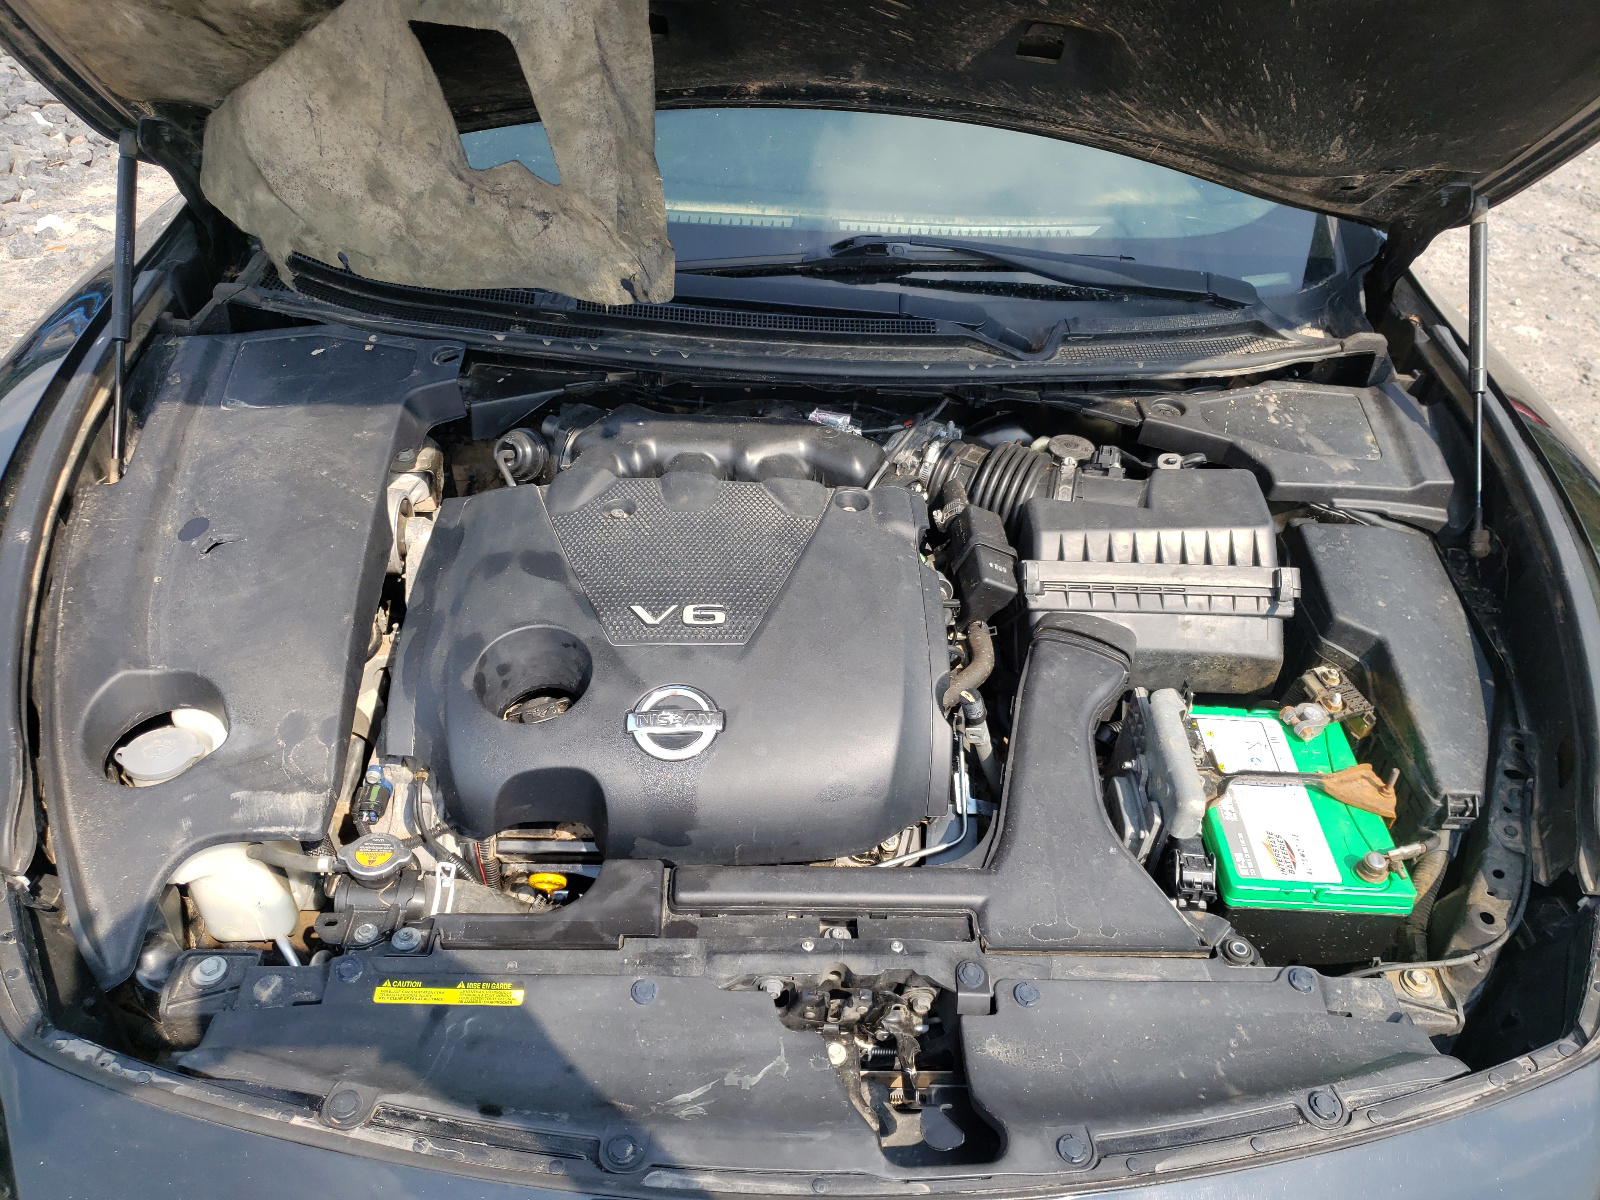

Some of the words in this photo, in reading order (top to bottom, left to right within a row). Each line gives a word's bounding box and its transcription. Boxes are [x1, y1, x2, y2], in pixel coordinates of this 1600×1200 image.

[628, 604, 727, 627] V6
[636, 712, 714, 727] NISSAN
[1265, 830, 1287, 876] INTERSTATE
[1274, 834, 1295, 876] BATTERIES
[392, 980, 422, 988] CAUTION
[491, 982, 512, 990] GARDE
